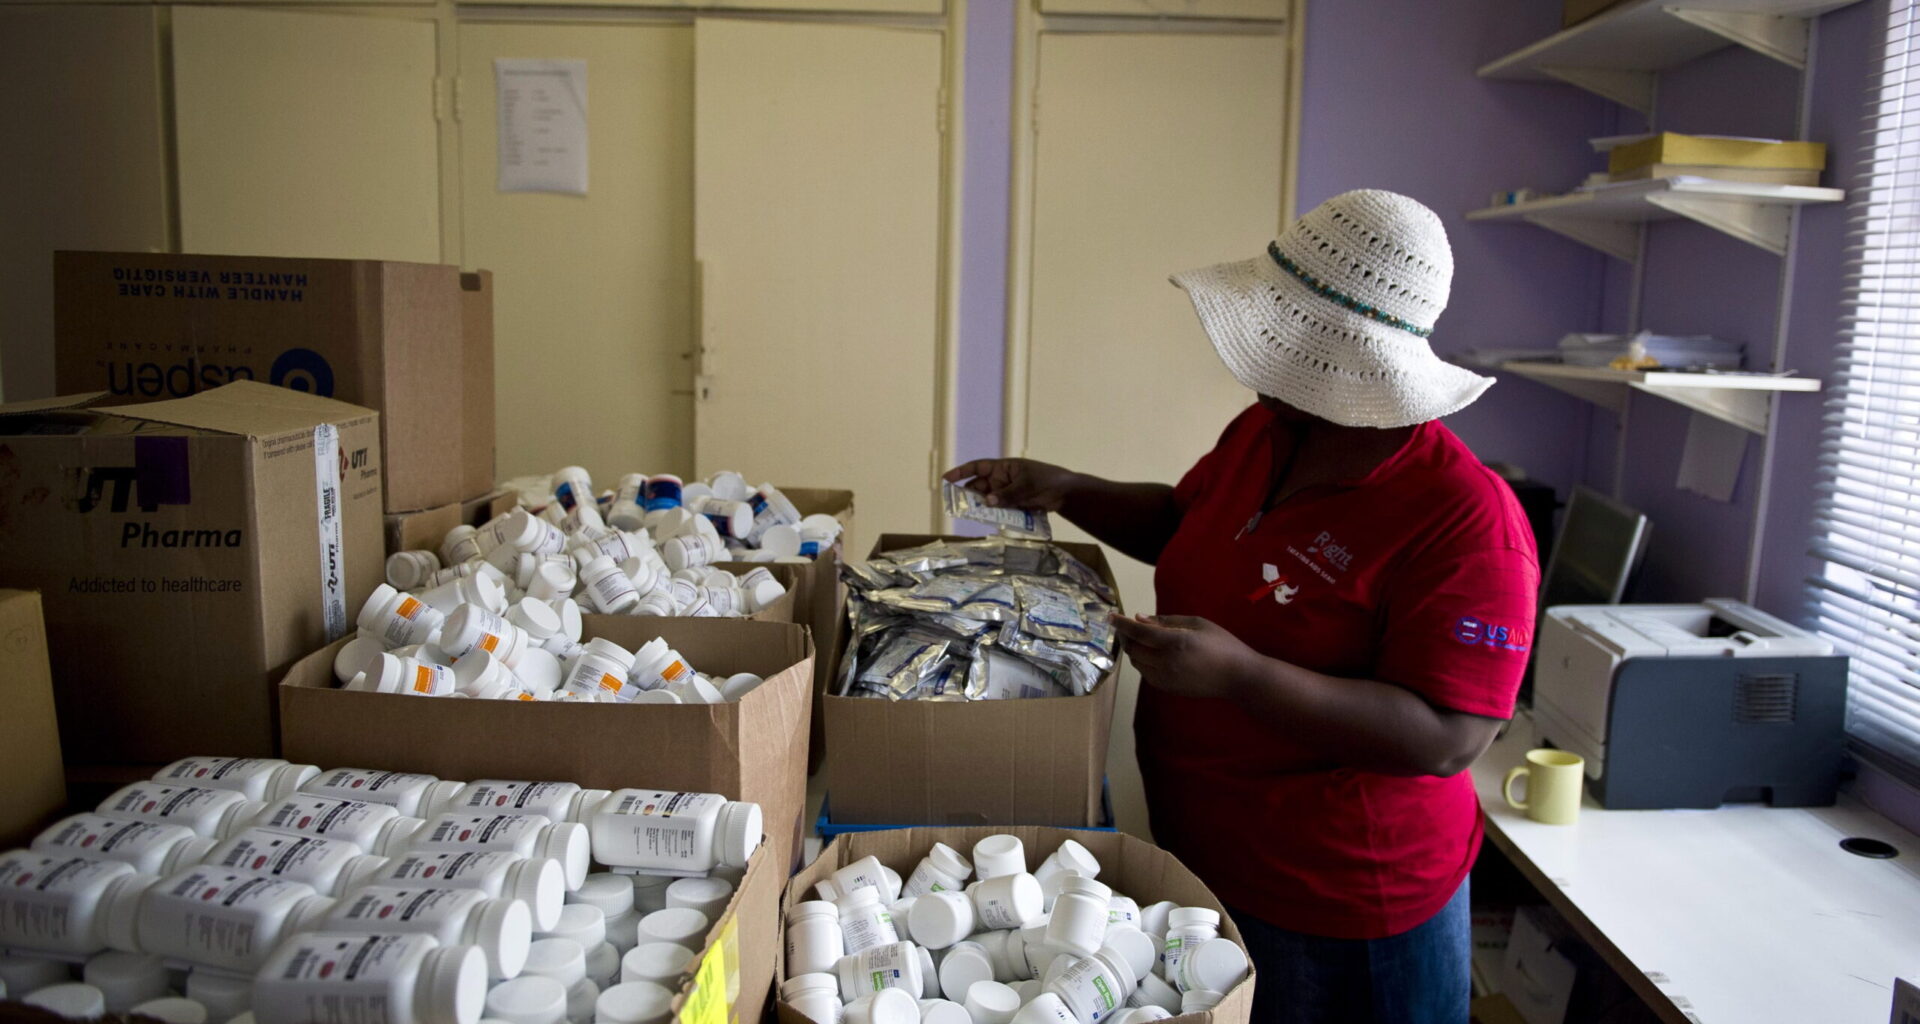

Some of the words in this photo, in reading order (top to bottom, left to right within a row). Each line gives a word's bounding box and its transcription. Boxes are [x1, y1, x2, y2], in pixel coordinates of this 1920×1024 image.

[112, 267, 211, 283] VERSIGTIG
[219, 271, 307, 285] HANTEER
[118, 283, 166, 298] CARE
[173, 285, 220, 299] WITH
[228, 287, 302, 302] HANDLE
[323, 487, 331, 520] FRAGILE
[121, 522, 242, 548] Pharma
[1313, 529, 1354, 567] Right
[69, 575, 136, 593] Addicted
[141, 577, 156, 593] to
[162, 576, 242, 593] healthcare
